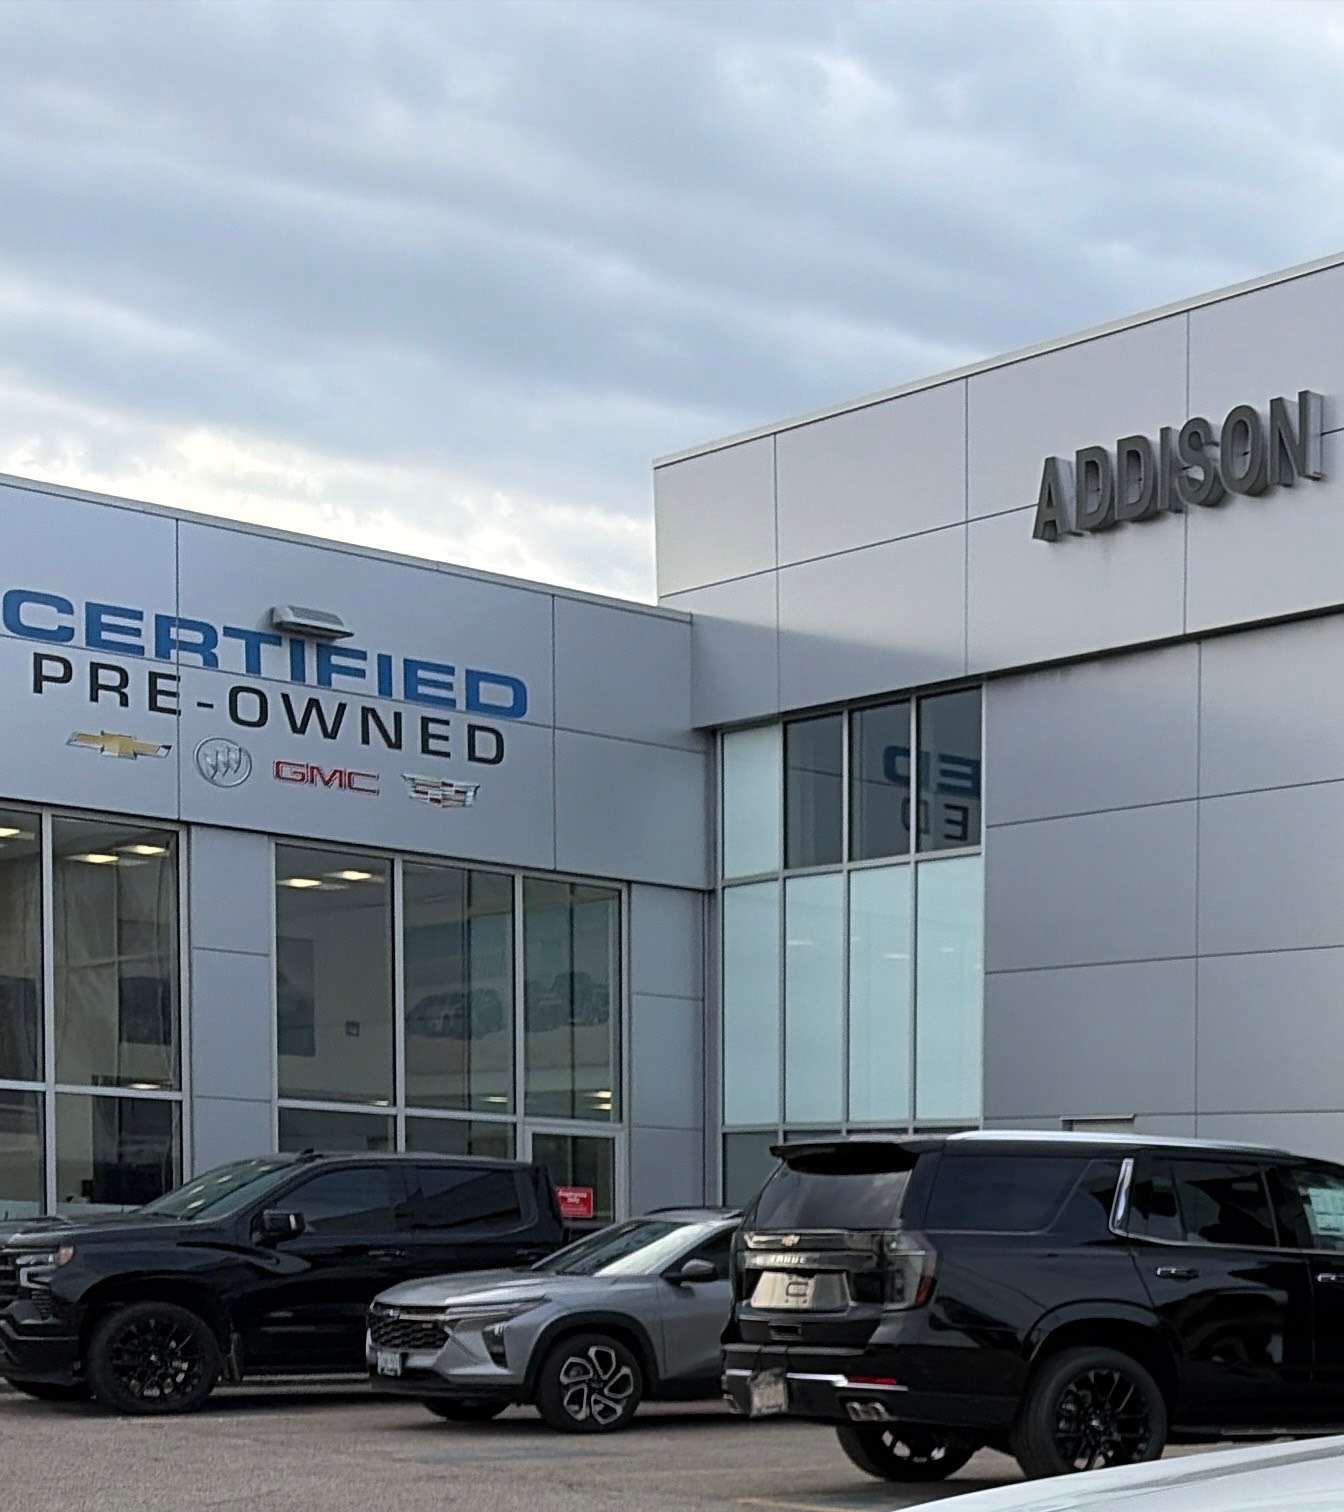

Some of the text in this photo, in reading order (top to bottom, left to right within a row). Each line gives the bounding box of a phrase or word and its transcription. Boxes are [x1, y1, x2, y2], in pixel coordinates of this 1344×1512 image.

[1033, 390, 1325, 542] ADDISON
[2, 589, 528, 719] CERTIFIED
[33, 652, 504, 765] PRE-OWNED
[273, 760, 380, 797] GMC
